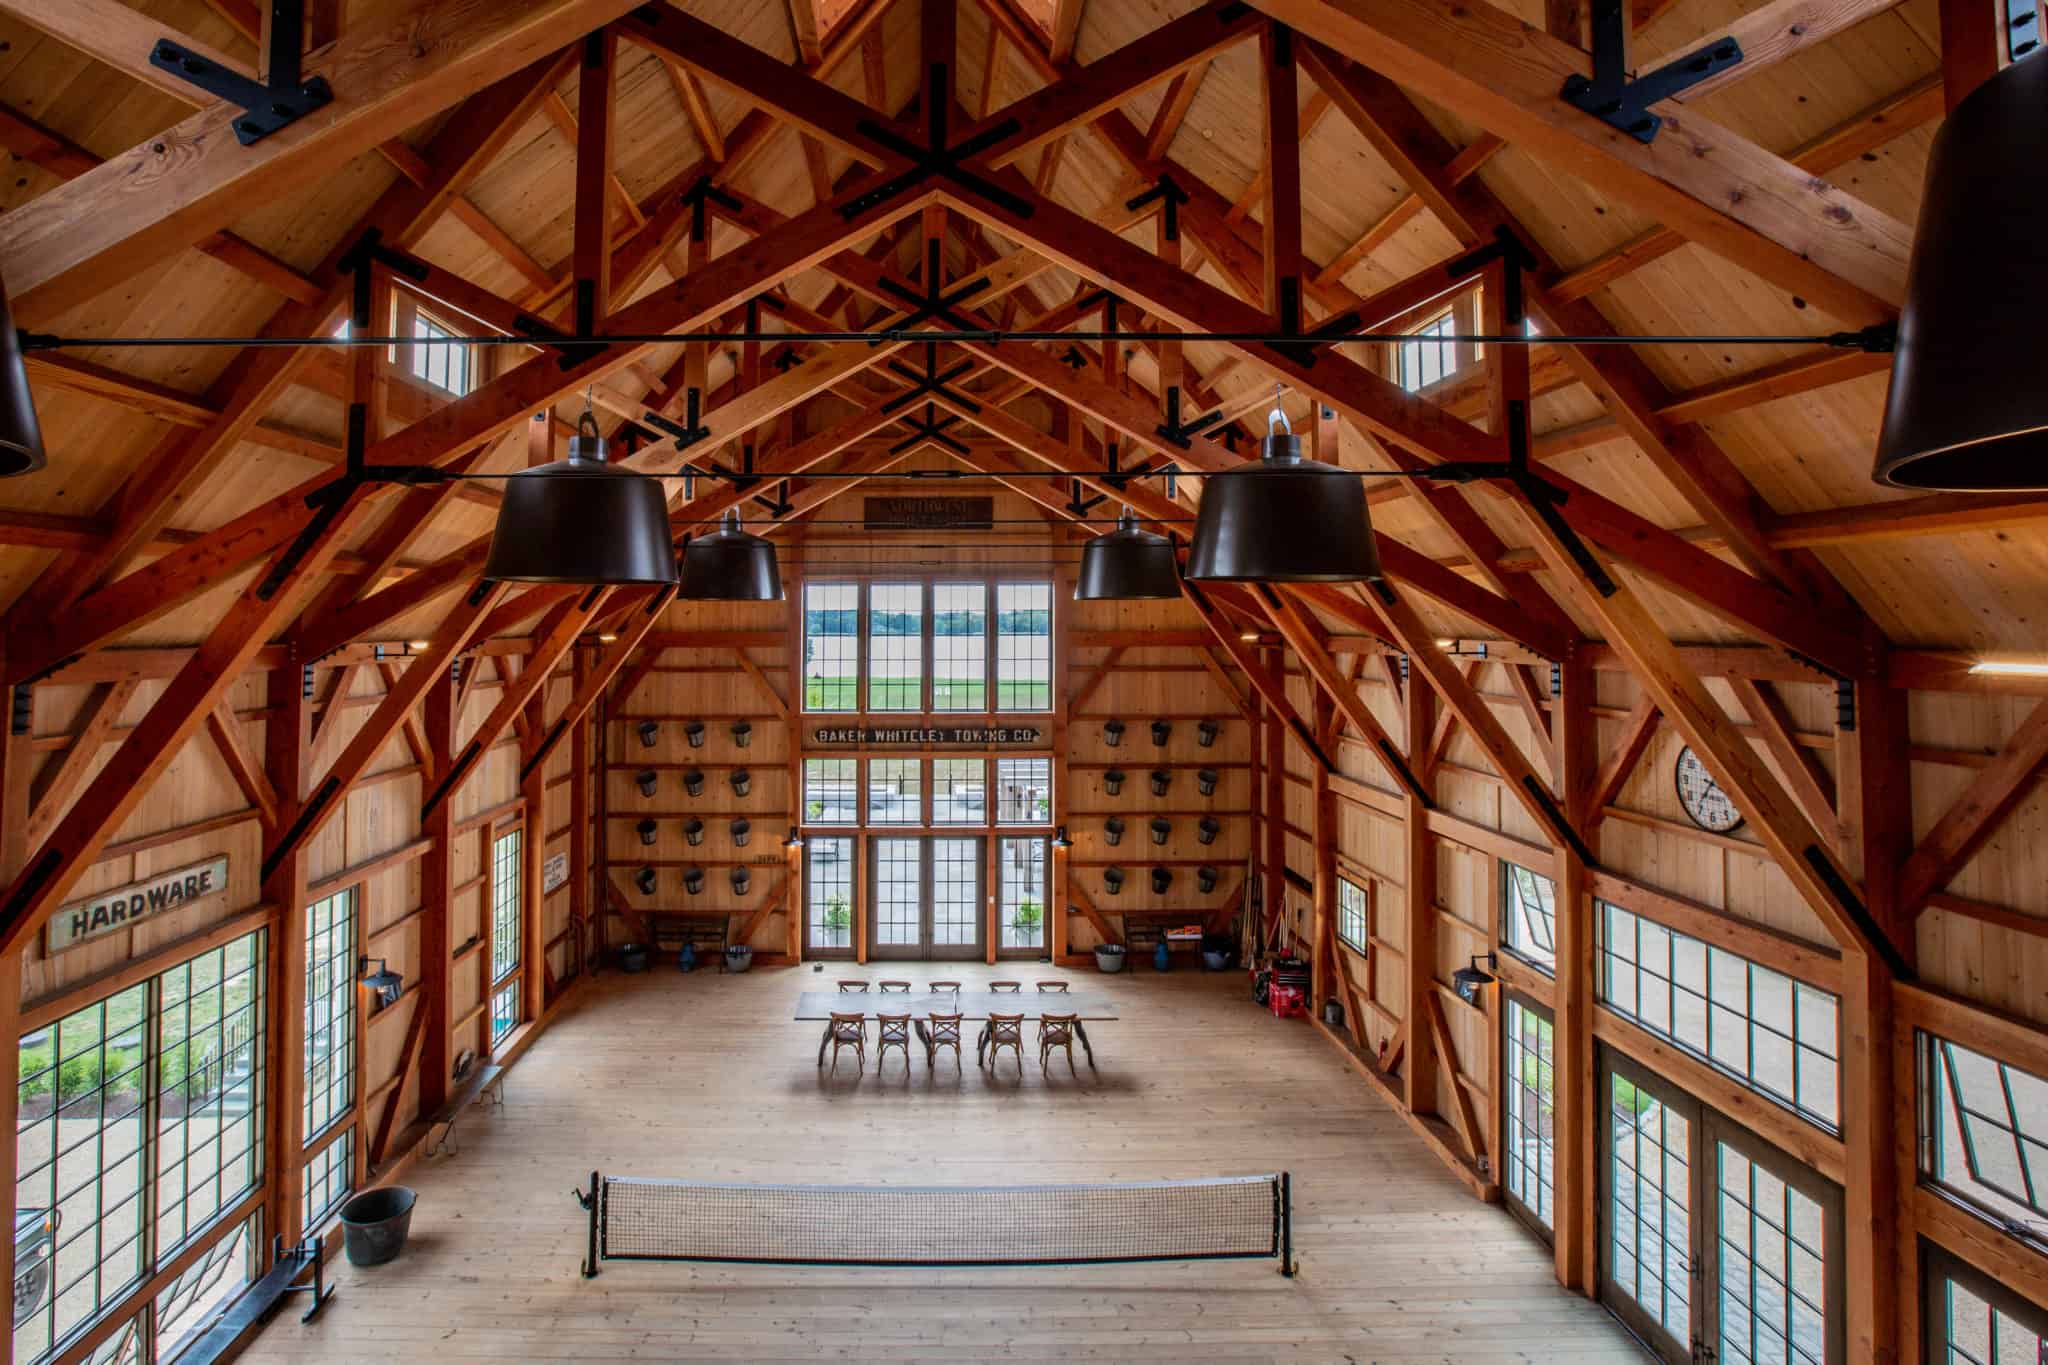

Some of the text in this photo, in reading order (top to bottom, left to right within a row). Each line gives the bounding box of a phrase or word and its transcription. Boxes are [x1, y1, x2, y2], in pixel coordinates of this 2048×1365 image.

[819, 730, 865, 742] BAKER
[954, 730, 1007, 742] TOWING
[71, 869, 213, 938] HARDWARE
